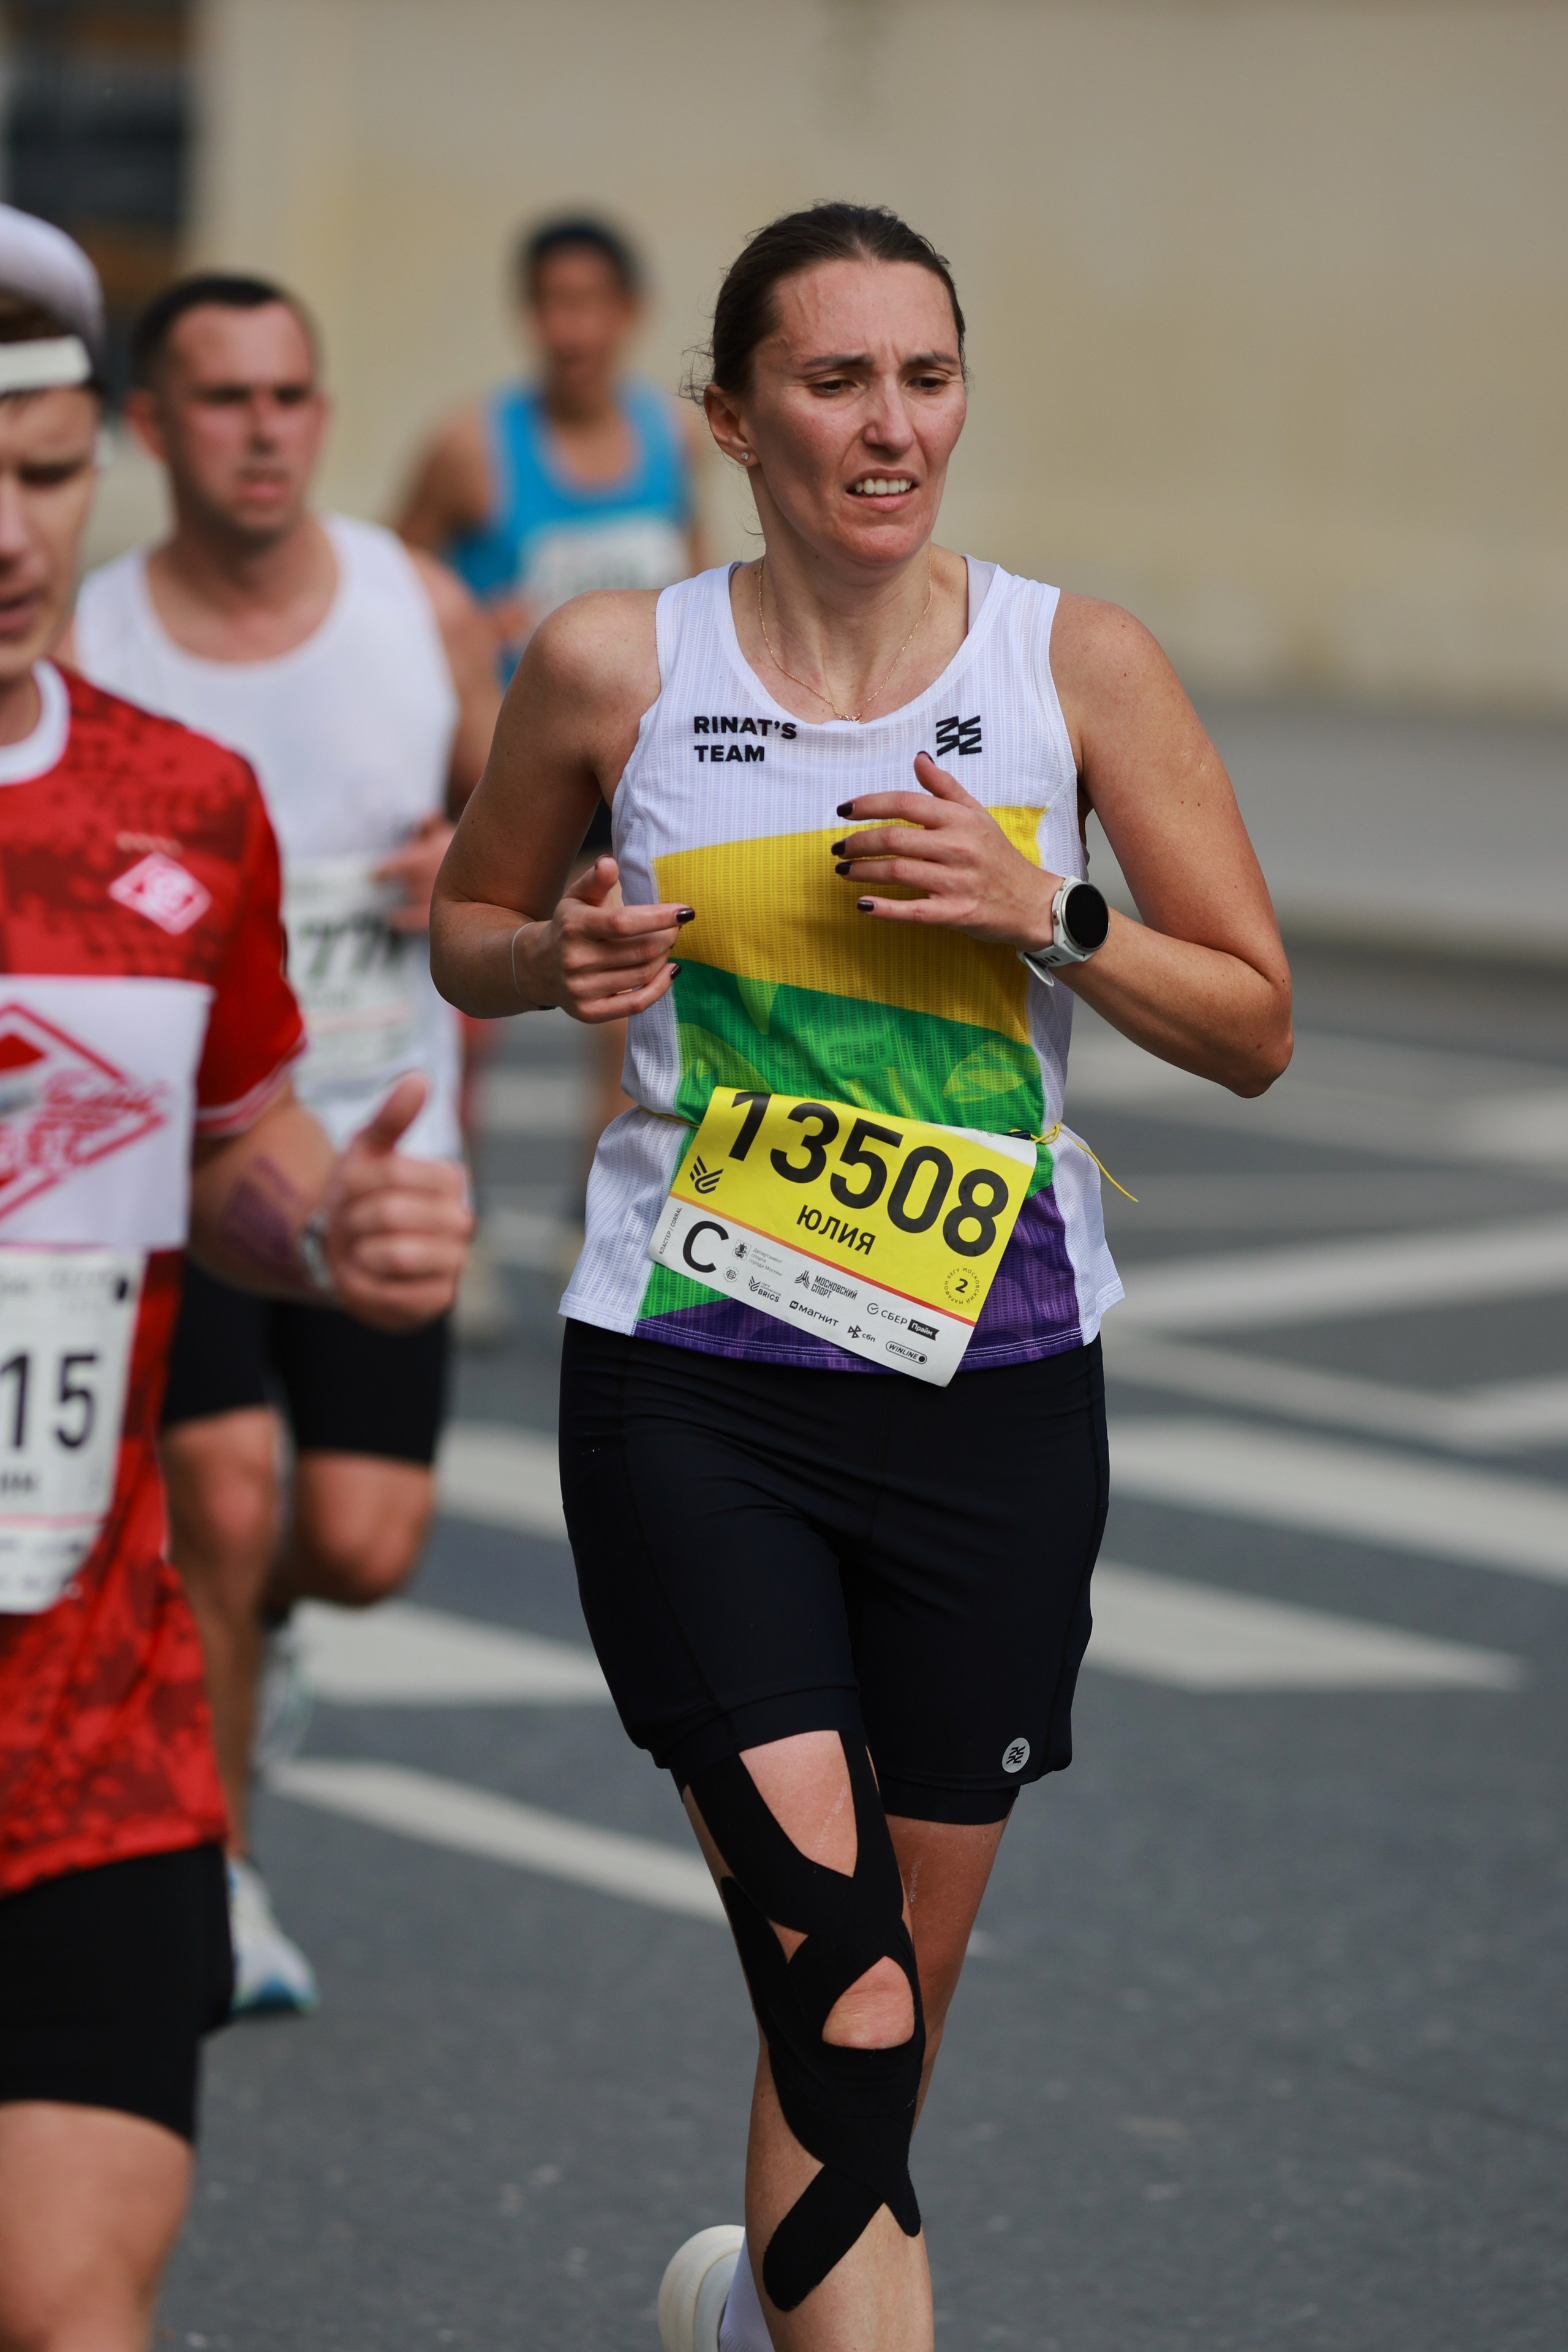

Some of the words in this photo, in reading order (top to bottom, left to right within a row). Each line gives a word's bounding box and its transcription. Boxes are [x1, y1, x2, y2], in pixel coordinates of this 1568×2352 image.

[694, 715, 797, 740] RINAT'S
[694, 744, 765, 763] TEAM
[729, 1091, 1009, 1257] 13508
[658, 1231, 671, 1254] КЛАСТЕР
[670, 1207, 682, 1227] CORRAL
[796, 1204, 876, 1256] ЮЛИЯ
[682, 1220, 729, 1273] C
[947, 1268, 960, 1279] БЕГУ
[758, 1289, 780, 1302] BRICS
[810, 1283, 832, 1298] СПОРТ
[814, 1275, 858, 1300] МОСКОВСКИЙ
[956, 1278, 968, 1294] 2
[881, 1310, 908, 1325] СБЕР
[911, 1322, 933, 1336] Прайм
[862, 1333, 876, 1342] сбп
[889, 1343, 919, 1360] WINLINE
